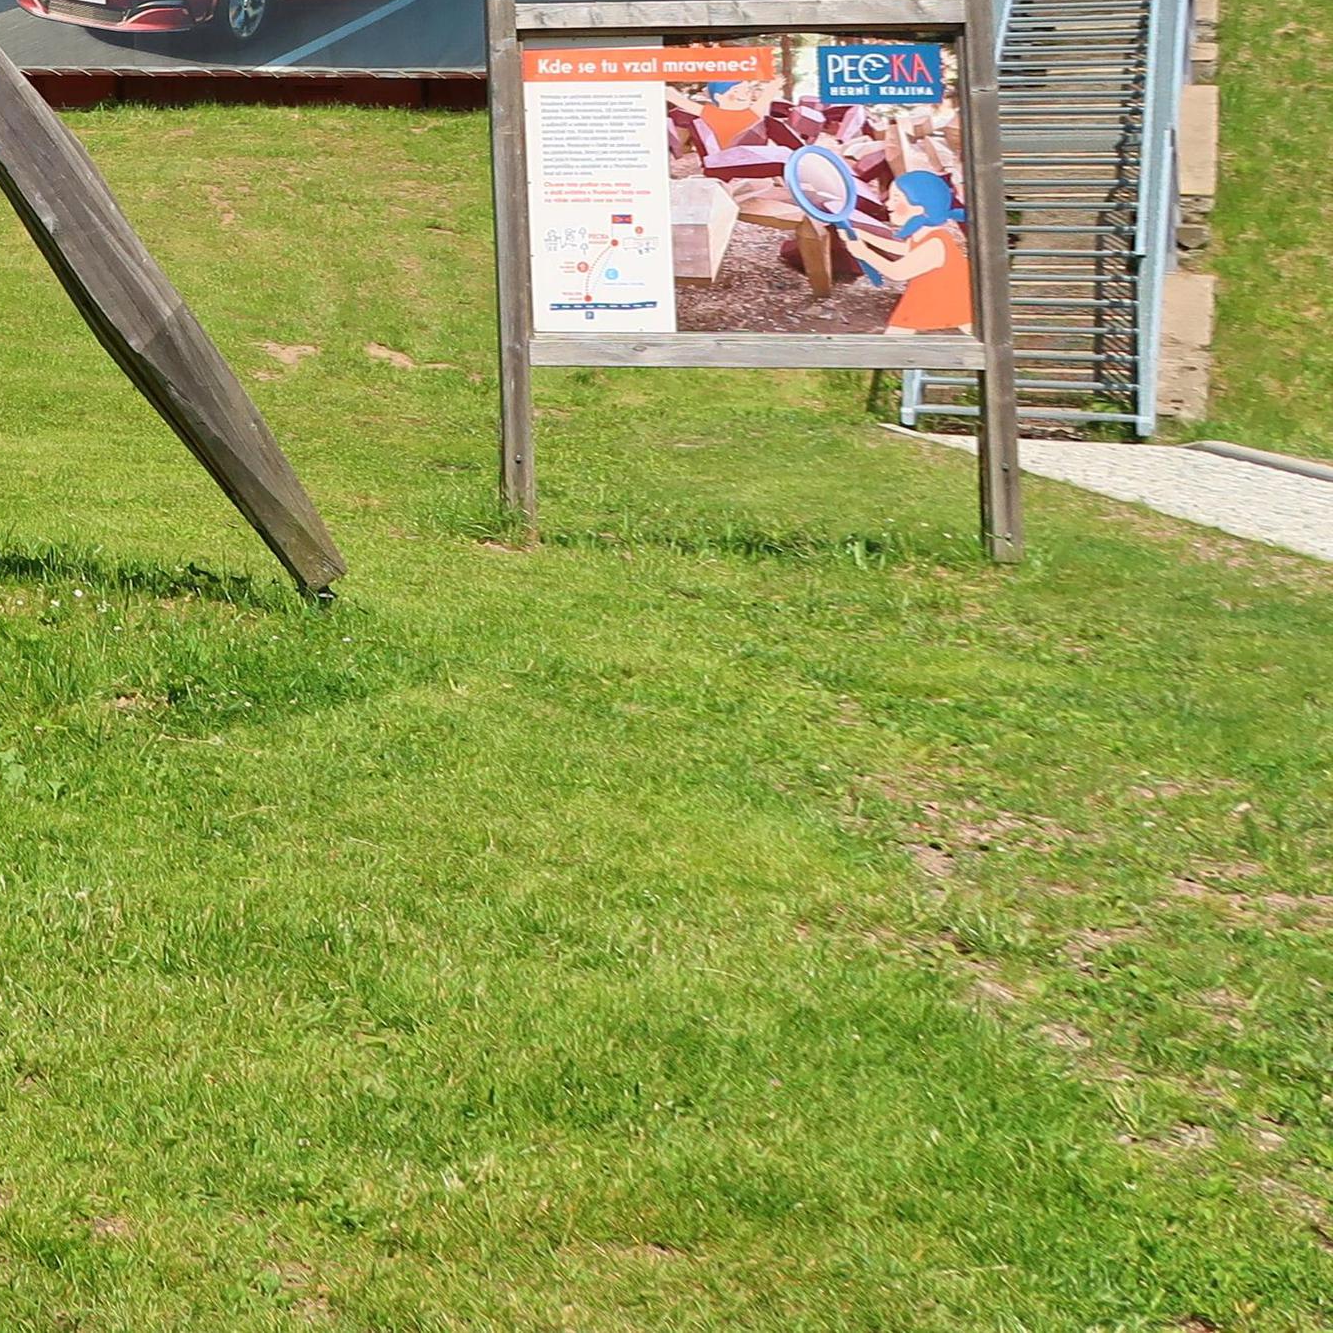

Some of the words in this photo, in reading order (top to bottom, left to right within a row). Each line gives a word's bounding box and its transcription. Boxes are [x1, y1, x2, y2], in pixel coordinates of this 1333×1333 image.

[537, 58, 573, 74] Kde
[577, 61, 597, 74] se
[600, 59, 618, 73] tu
[622, 57, 658, 73] vzal
[662, 55, 759, 73] mravenec?
[826, 52, 934, 85] PECKA
[829, 83, 871, 96] HERNÍ
[878, 85, 935, 96] KRAJINA
